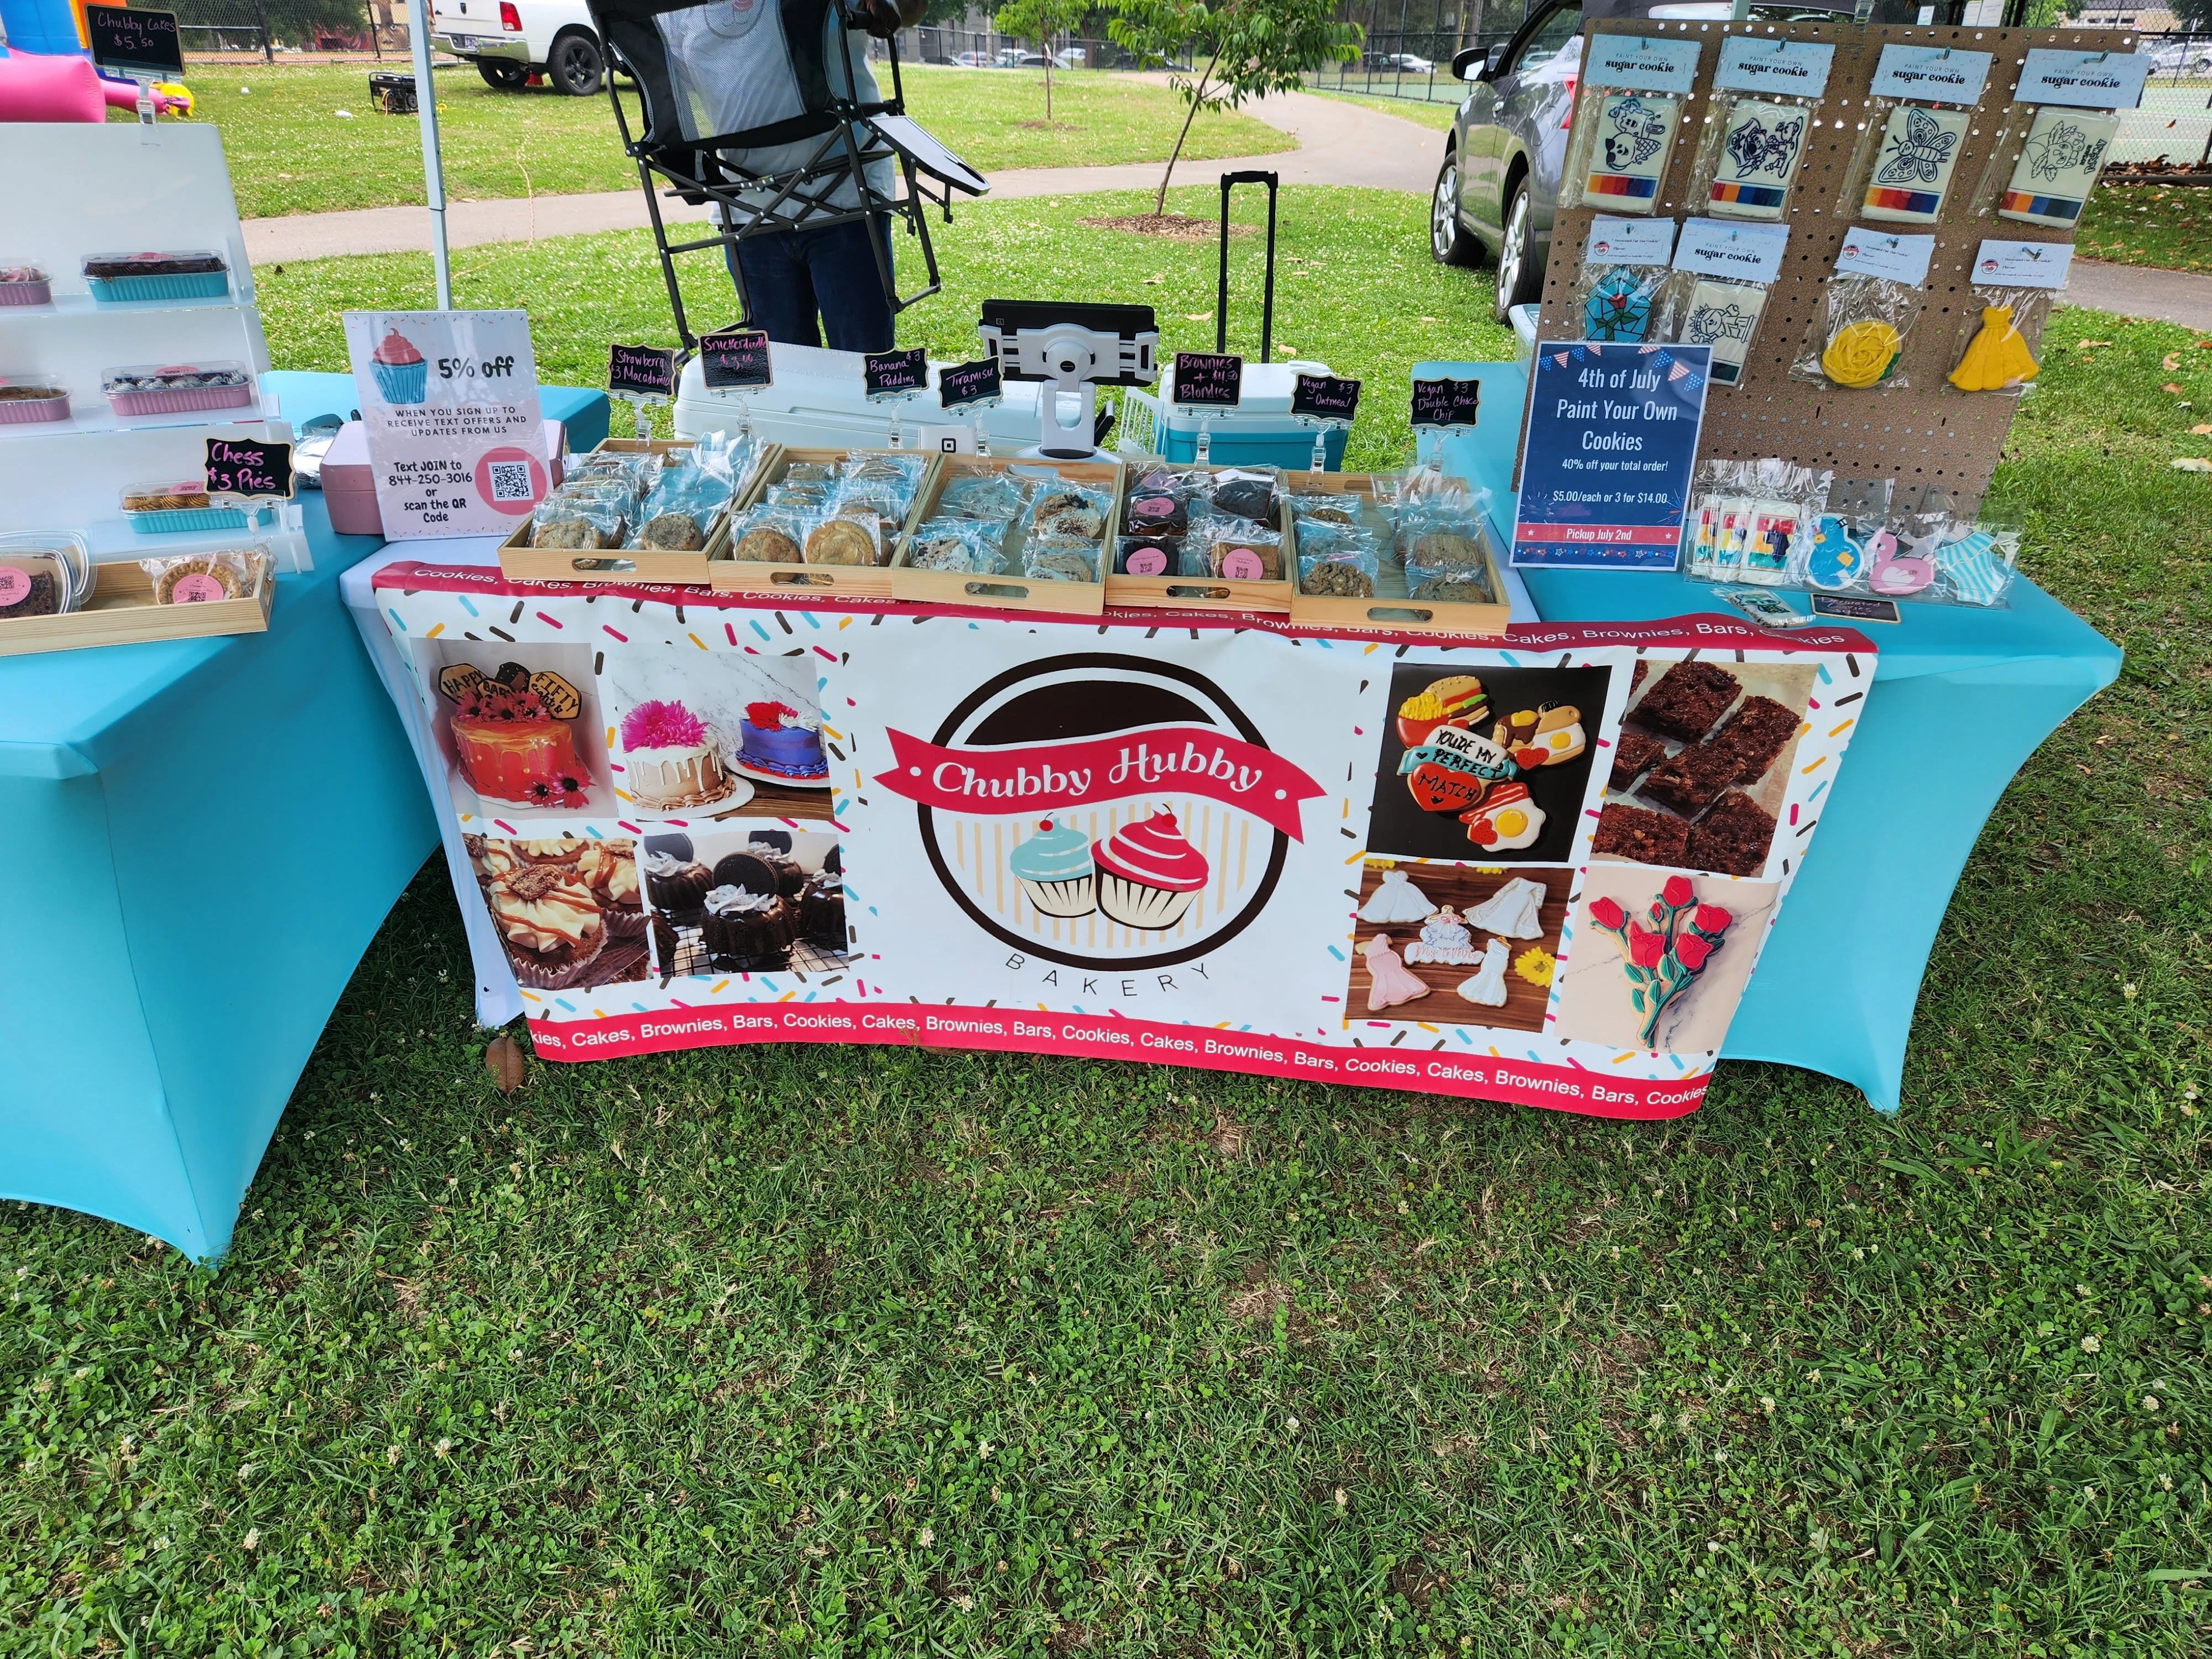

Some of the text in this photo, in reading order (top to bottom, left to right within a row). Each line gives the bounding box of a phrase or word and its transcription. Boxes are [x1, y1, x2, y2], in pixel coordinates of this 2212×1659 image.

[98, 12, 176, 38] Chubby Cakes
[1605, 60, 1674, 73] sugar cookie
[1738, 62, 1808, 77] sugar cookie
[1892, 71, 1965, 84] sugar cookie
[2041, 76, 2120, 89] sugar cookie
[1694, 248, 1761, 264] sugar cookie
[438, 356, 515, 379] 5% off
[615, 349, 664, 377] Strawberry
[870, 359, 909, 372] Banana
[1180, 355, 1234, 370] Brownies
[879, 374, 915, 387] Pudding
[946, 367, 994, 387] Tiramisu
[1578, 368, 1661, 392] 4th of July
[1180, 383, 1230, 399] Blondies
[1303, 377, 1326, 394] Vegan
[1418, 382, 1443, 400] Vegan
[1316, 393, 1352, 407] Oatmeal
[1418, 396, 1449, 410] Double
[1433, 409, 1454, 421] Chip
[1557, 399, 1677, 421] Paint Your Own
[388, 419, 430, 427] RECEIVE
[411, 428, 457, 436] UPDATES
[1582, 431, 1642, 451] Cookies
[211, 442, 264, 466] Chess
[394, 460, 462, 472] Text JOIN to
[1562, 458, 1668, 472] 40% off your total order!
[237, 468, 276, 490] Pies
[389, 472, 472, 486] 844-250-3016
[425, 488, 437, 497] or
[1553, 491, 1667, 504] $5.00/each or 3 for $14.00
[404, 498, 467, 510] scan the QR
[423, 513, 449, 523] Code
[1567, 529, 1631, 541] Pickup July 2nd
[414, 569, 498, 585] Cookies,
[684, 586, 733, 598] Bars,
[743, 591, 825, 602] Cookies,
[1165, 612, 1233, 620] Cakes,
[1503, 633, 1575, 645] Cakes,
[1583, 629, 1690, 639] Brownies,
[1695, 623, 1754, 637] Bars,
[535, 673, 578, 712] FIFTY
[1478, 747, 1497, 763] MY
[933, 742, 1263, 798] Chubby Hubby
[1432, 749, 1502, 778] PERFECT
[1417, 774, 1477, 801] MATCH
[1005, 952, 1209, 997] BAKERY
[530, 1013, 1708, 1105] kies, Cakes, Brownies, Bars, Cookies, Cakes, Brownies, Bars, Cookies, Cakes, Brownies, Bars, Cookies, Cakes, Brownies, Bars, Cookies
